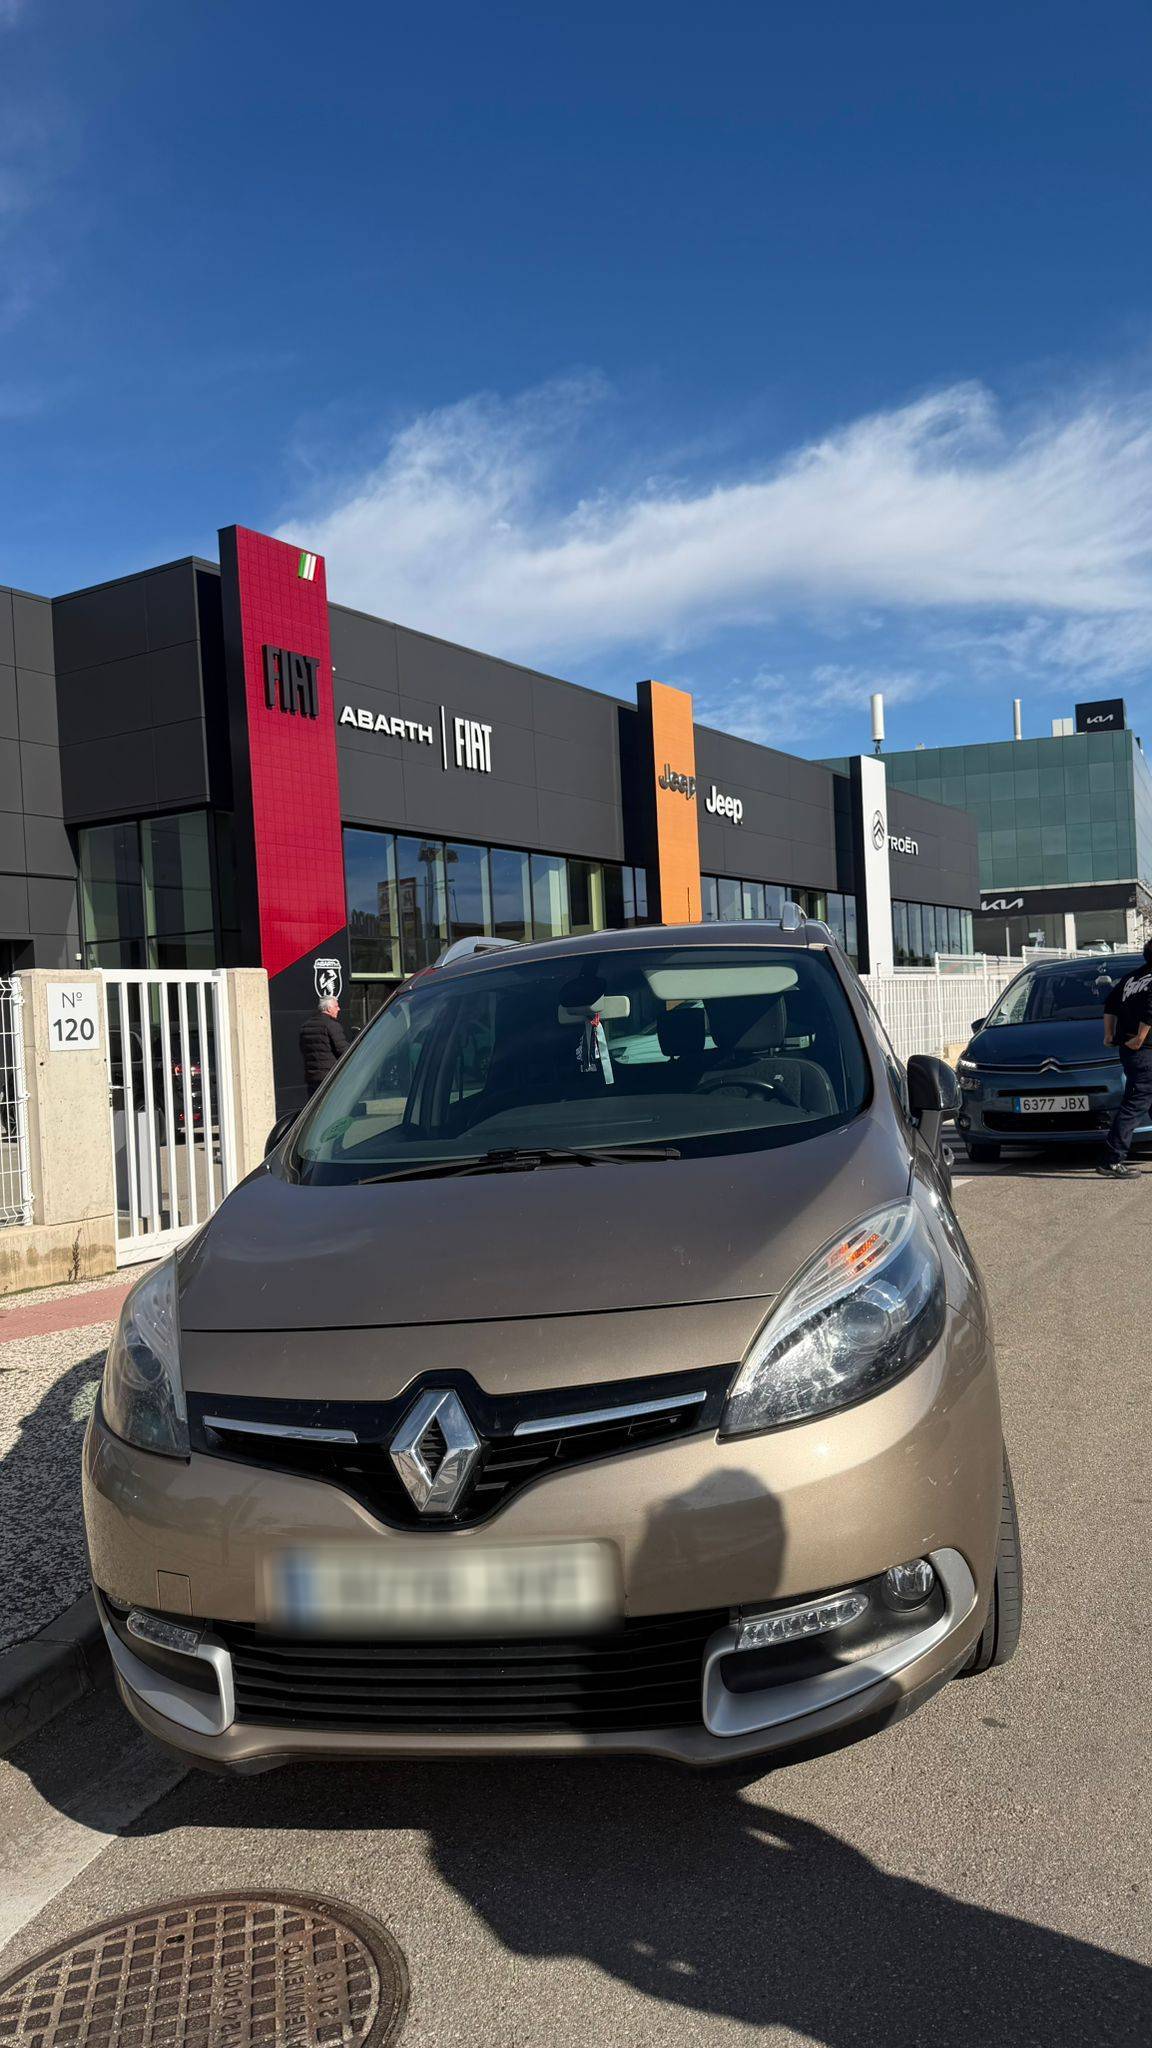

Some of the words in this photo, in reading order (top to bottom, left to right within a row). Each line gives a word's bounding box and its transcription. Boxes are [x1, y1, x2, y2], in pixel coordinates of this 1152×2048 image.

[262, 645, 320, 720] FIAT
[1086, 714, 1114, 725] KIA
[339, 705, 434, 746] ABARTH
[454, 717, 492, 773] FIAT
[658, 763, 697, 801] Jeep
[705, 785, 744, 825] Jeep
[887, 835, 919, 856] TROËN
[981, 897, 1024, 911] KIA
[62, 991, 83, 1008] Nº
[53, 1018, 95, 1041] 120
[1023, 1099, 1055, 1111] 6377
[1061, 1097, 1086, 1110] JBX
[283, 1945, 307, 2048] ANEAMIENTO
[316, 1971, 340, 2018] 2018
